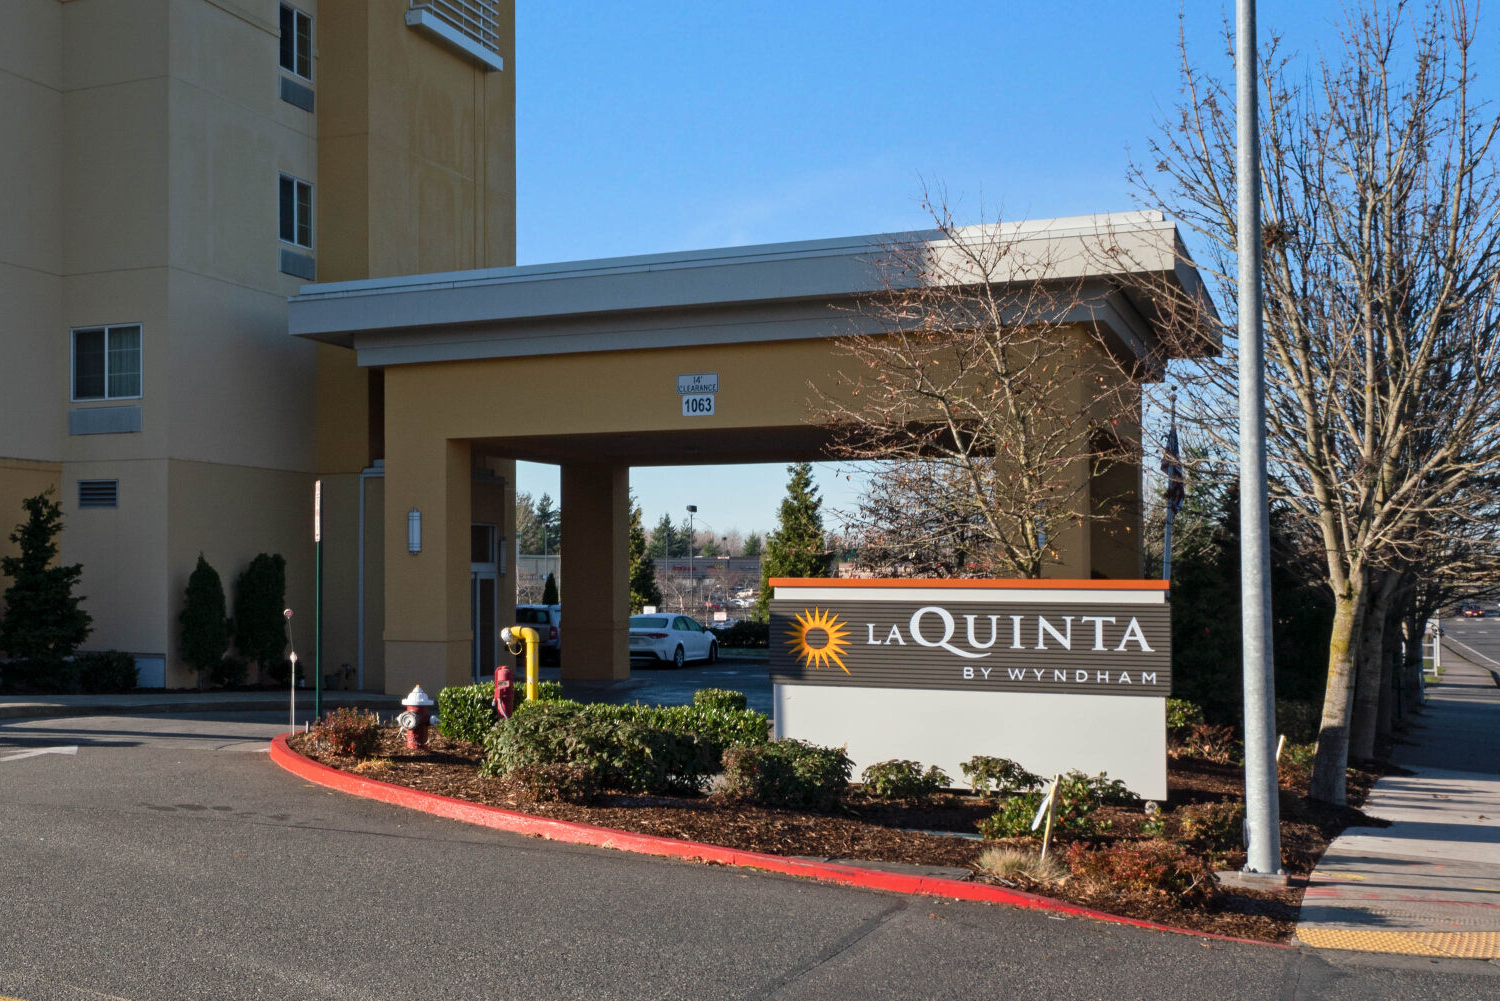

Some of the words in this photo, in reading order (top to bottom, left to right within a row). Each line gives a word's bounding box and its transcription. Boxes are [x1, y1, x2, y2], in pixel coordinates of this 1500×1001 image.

[678, 383, 716, 393] CLEARANCE
[684, 397, 712, 413] 1063
[866, 622, 907, 646] LA
[909, 606, 1155, 659] QUINTA
[963, 666, 993, 680] BY
[1007, 667, 1157, 685] WYNDHAM
